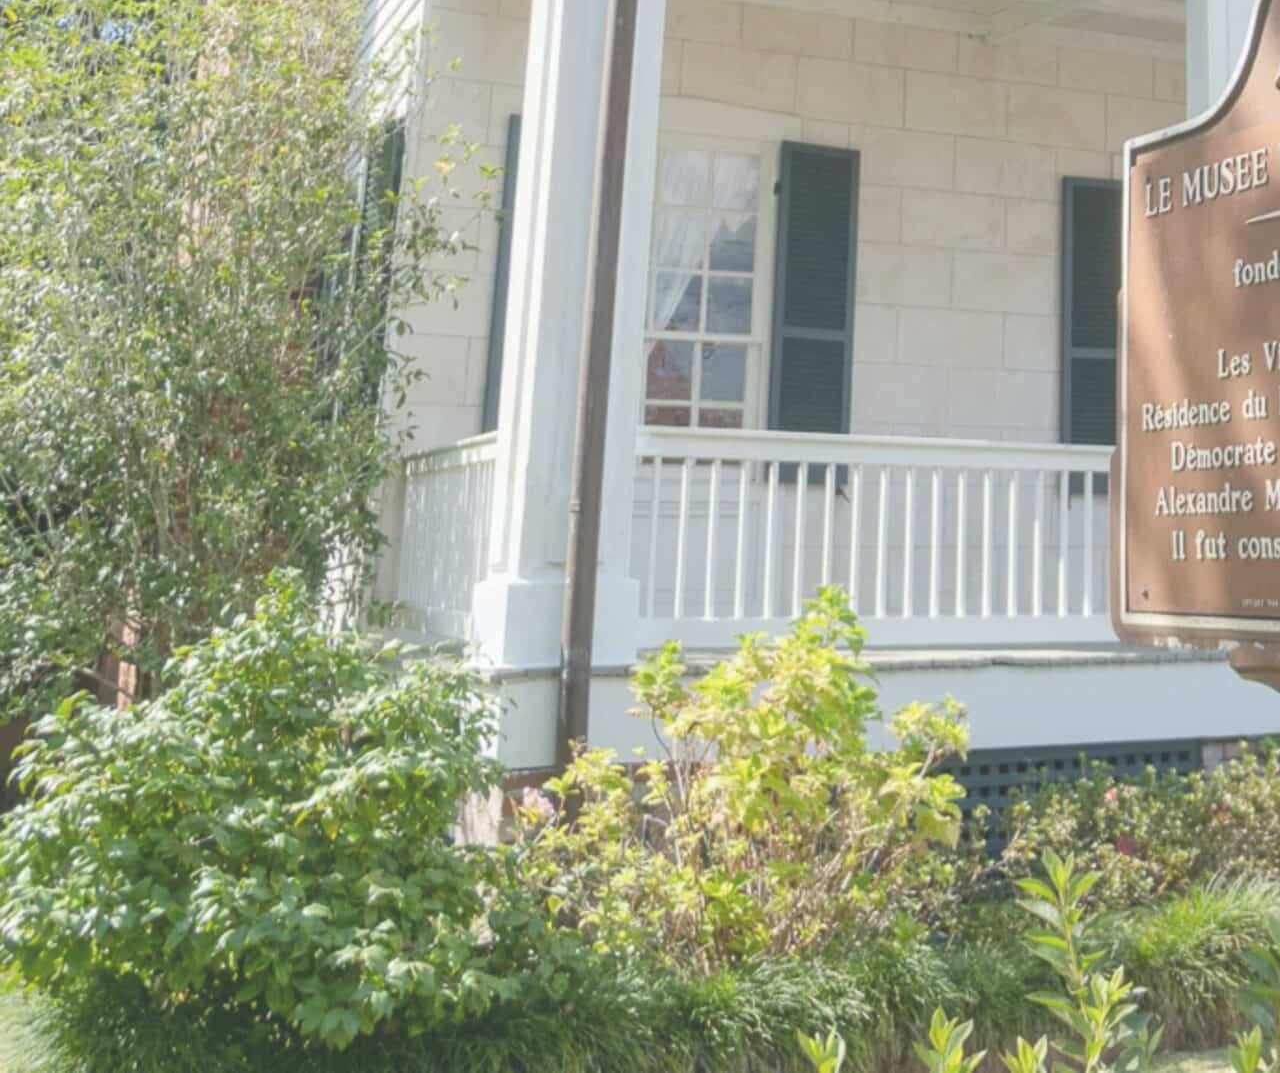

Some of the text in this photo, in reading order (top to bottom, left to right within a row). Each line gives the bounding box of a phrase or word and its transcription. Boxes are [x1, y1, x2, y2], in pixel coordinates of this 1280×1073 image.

[1145, 177, 1172, 217] LE
[1183, 147, 1268, 207] MUSEE
[1217, 349, 1250, 377] Les
[1142, 399, 1231, 431] Résidence
[1242, 389, 1267, 419] du
[1171, 436, 1276, 471] Démocrate
[1155, 482, 1253, 515] Alexandre
[1171, 530, 1185, 560] Il
[1195, 528, 1226, 560] fut
